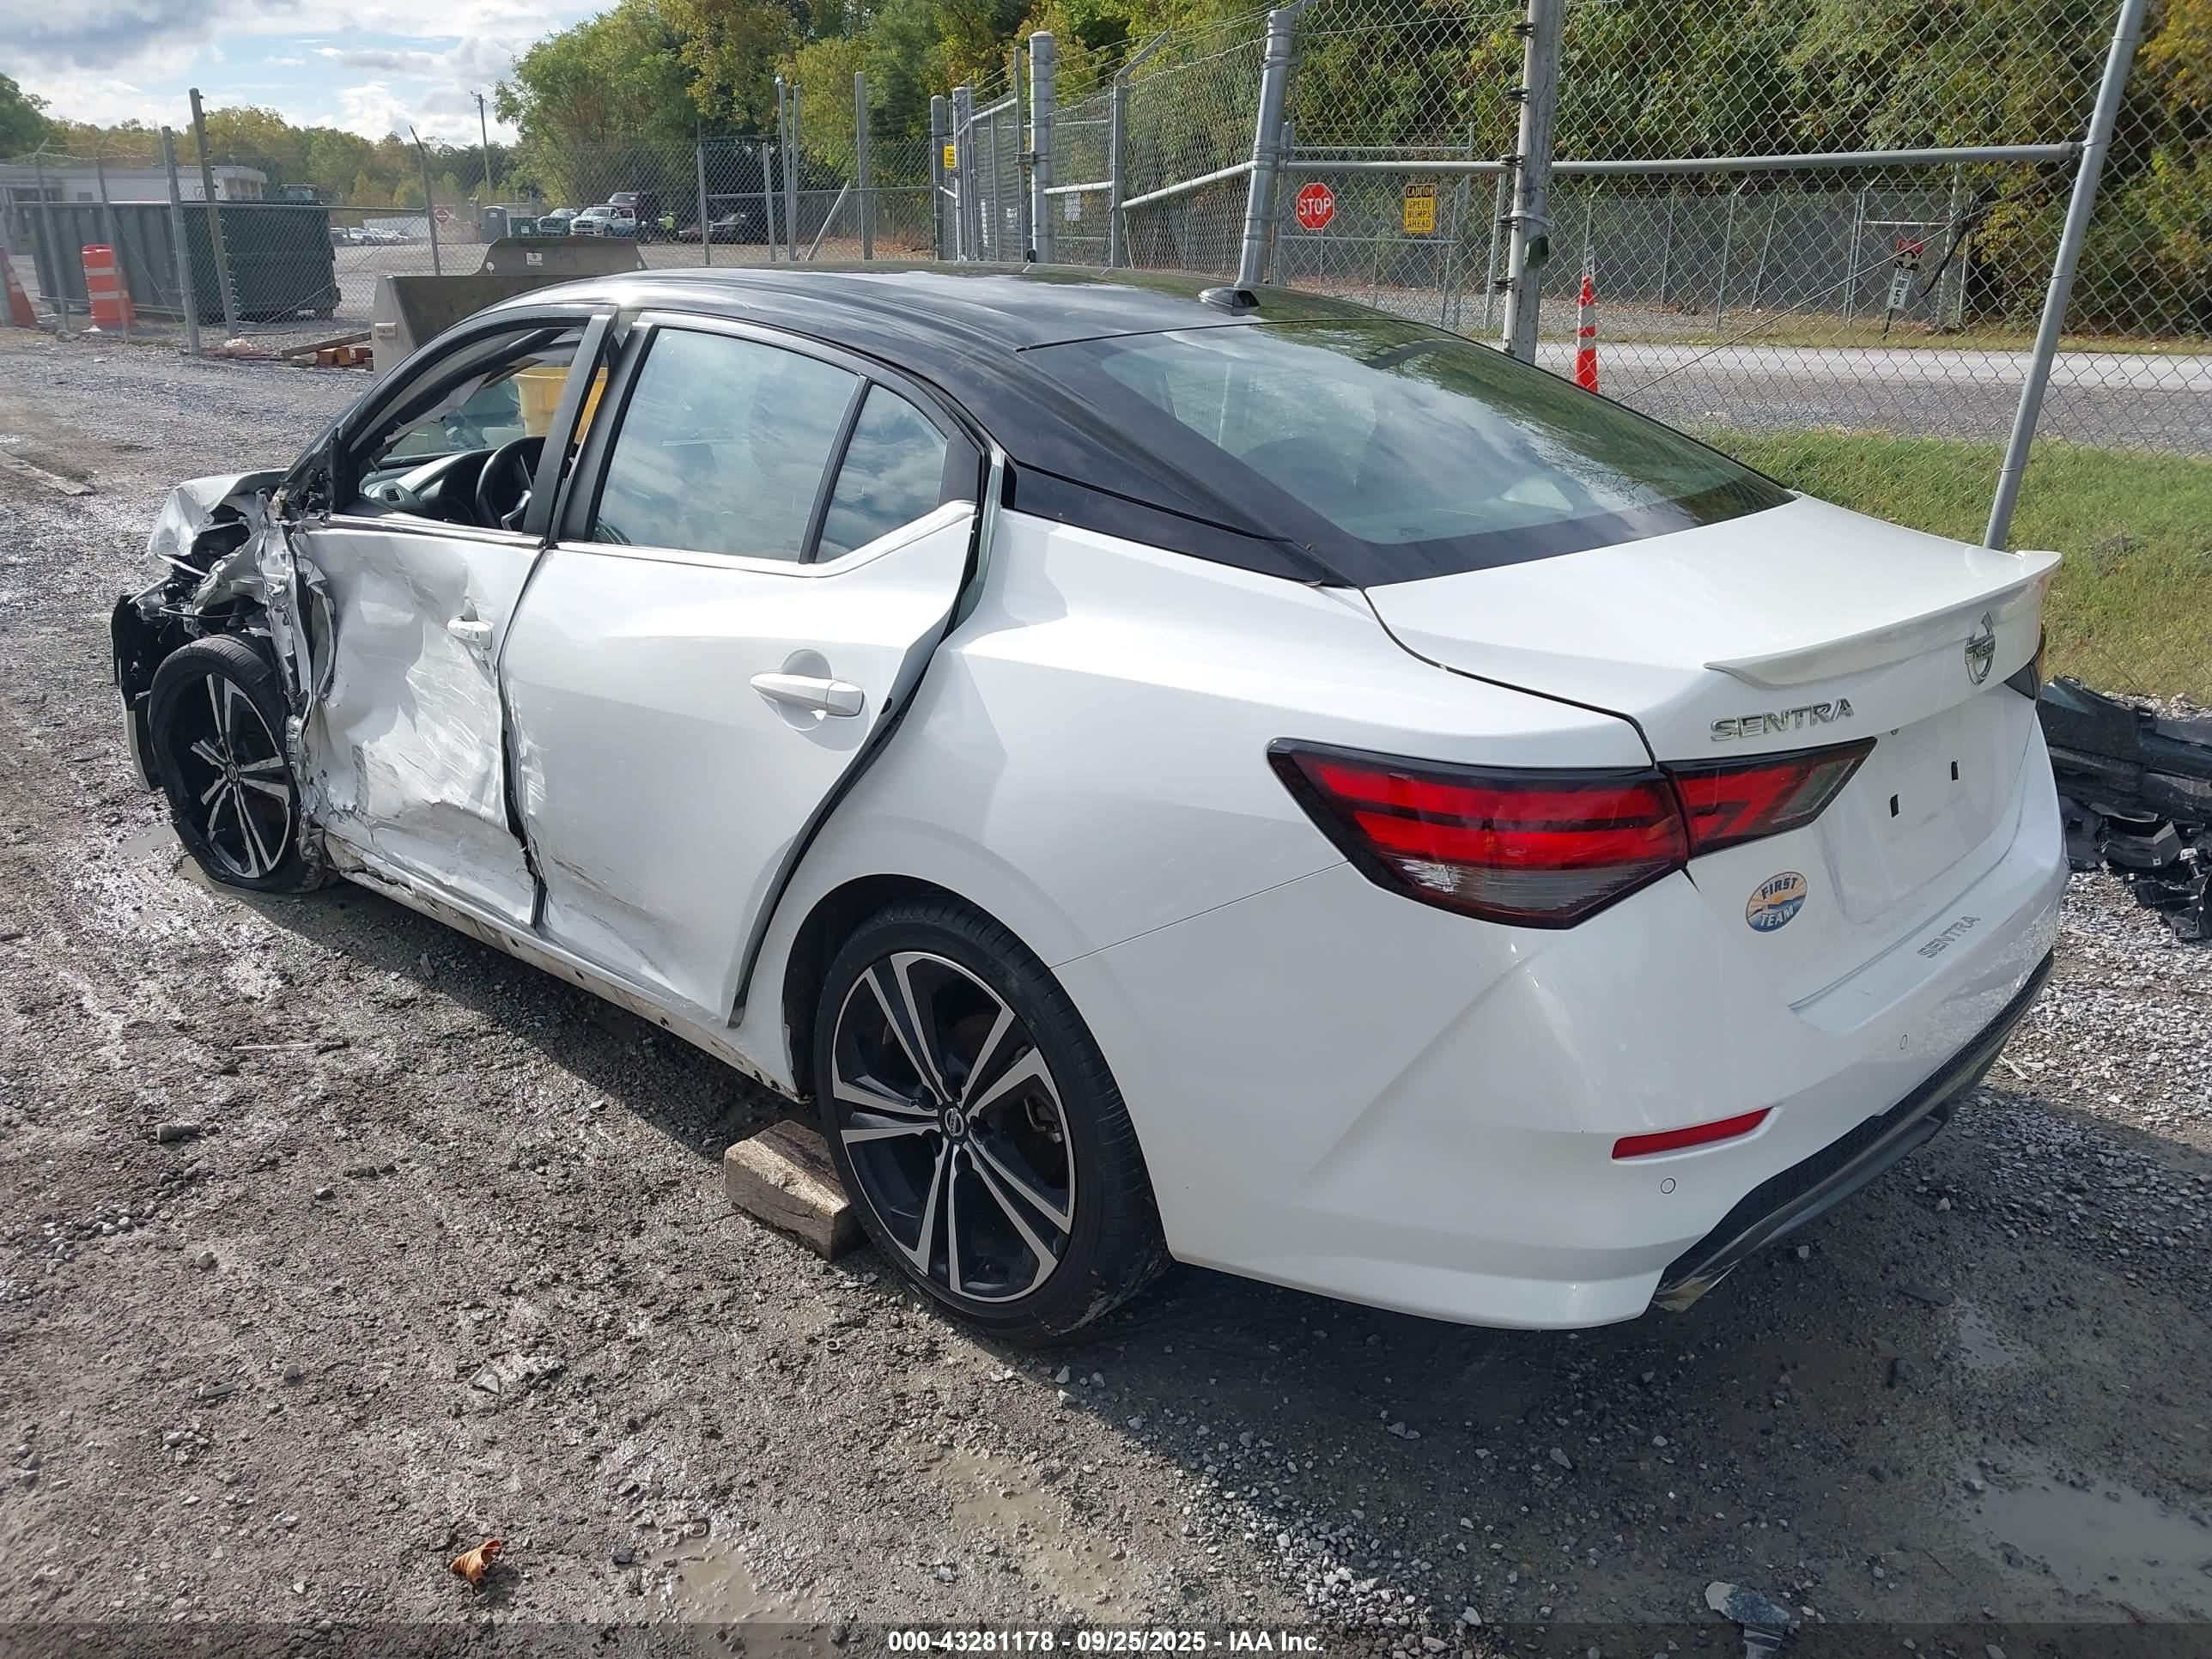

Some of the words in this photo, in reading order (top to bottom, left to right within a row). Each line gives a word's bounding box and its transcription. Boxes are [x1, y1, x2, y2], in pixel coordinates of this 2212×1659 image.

[1407, 185, 1434, 198] CAUTION
[1299, 198, 1332, 216] STOP
[1407, 210, 1431, 219] BUMPS
[1409, 200, 1431, 210] SPEED
[1407, 219, 1431, 228] AHEAD
[1972, 639, 1995, 659] NISS
[1710, 697, 1855, 742] SENTRA
[1761, 877, 1798, 900] FIRST
[1760, 904, 1794, 927] TEAM
[1917, 915, 1981, 958] SENTRA
